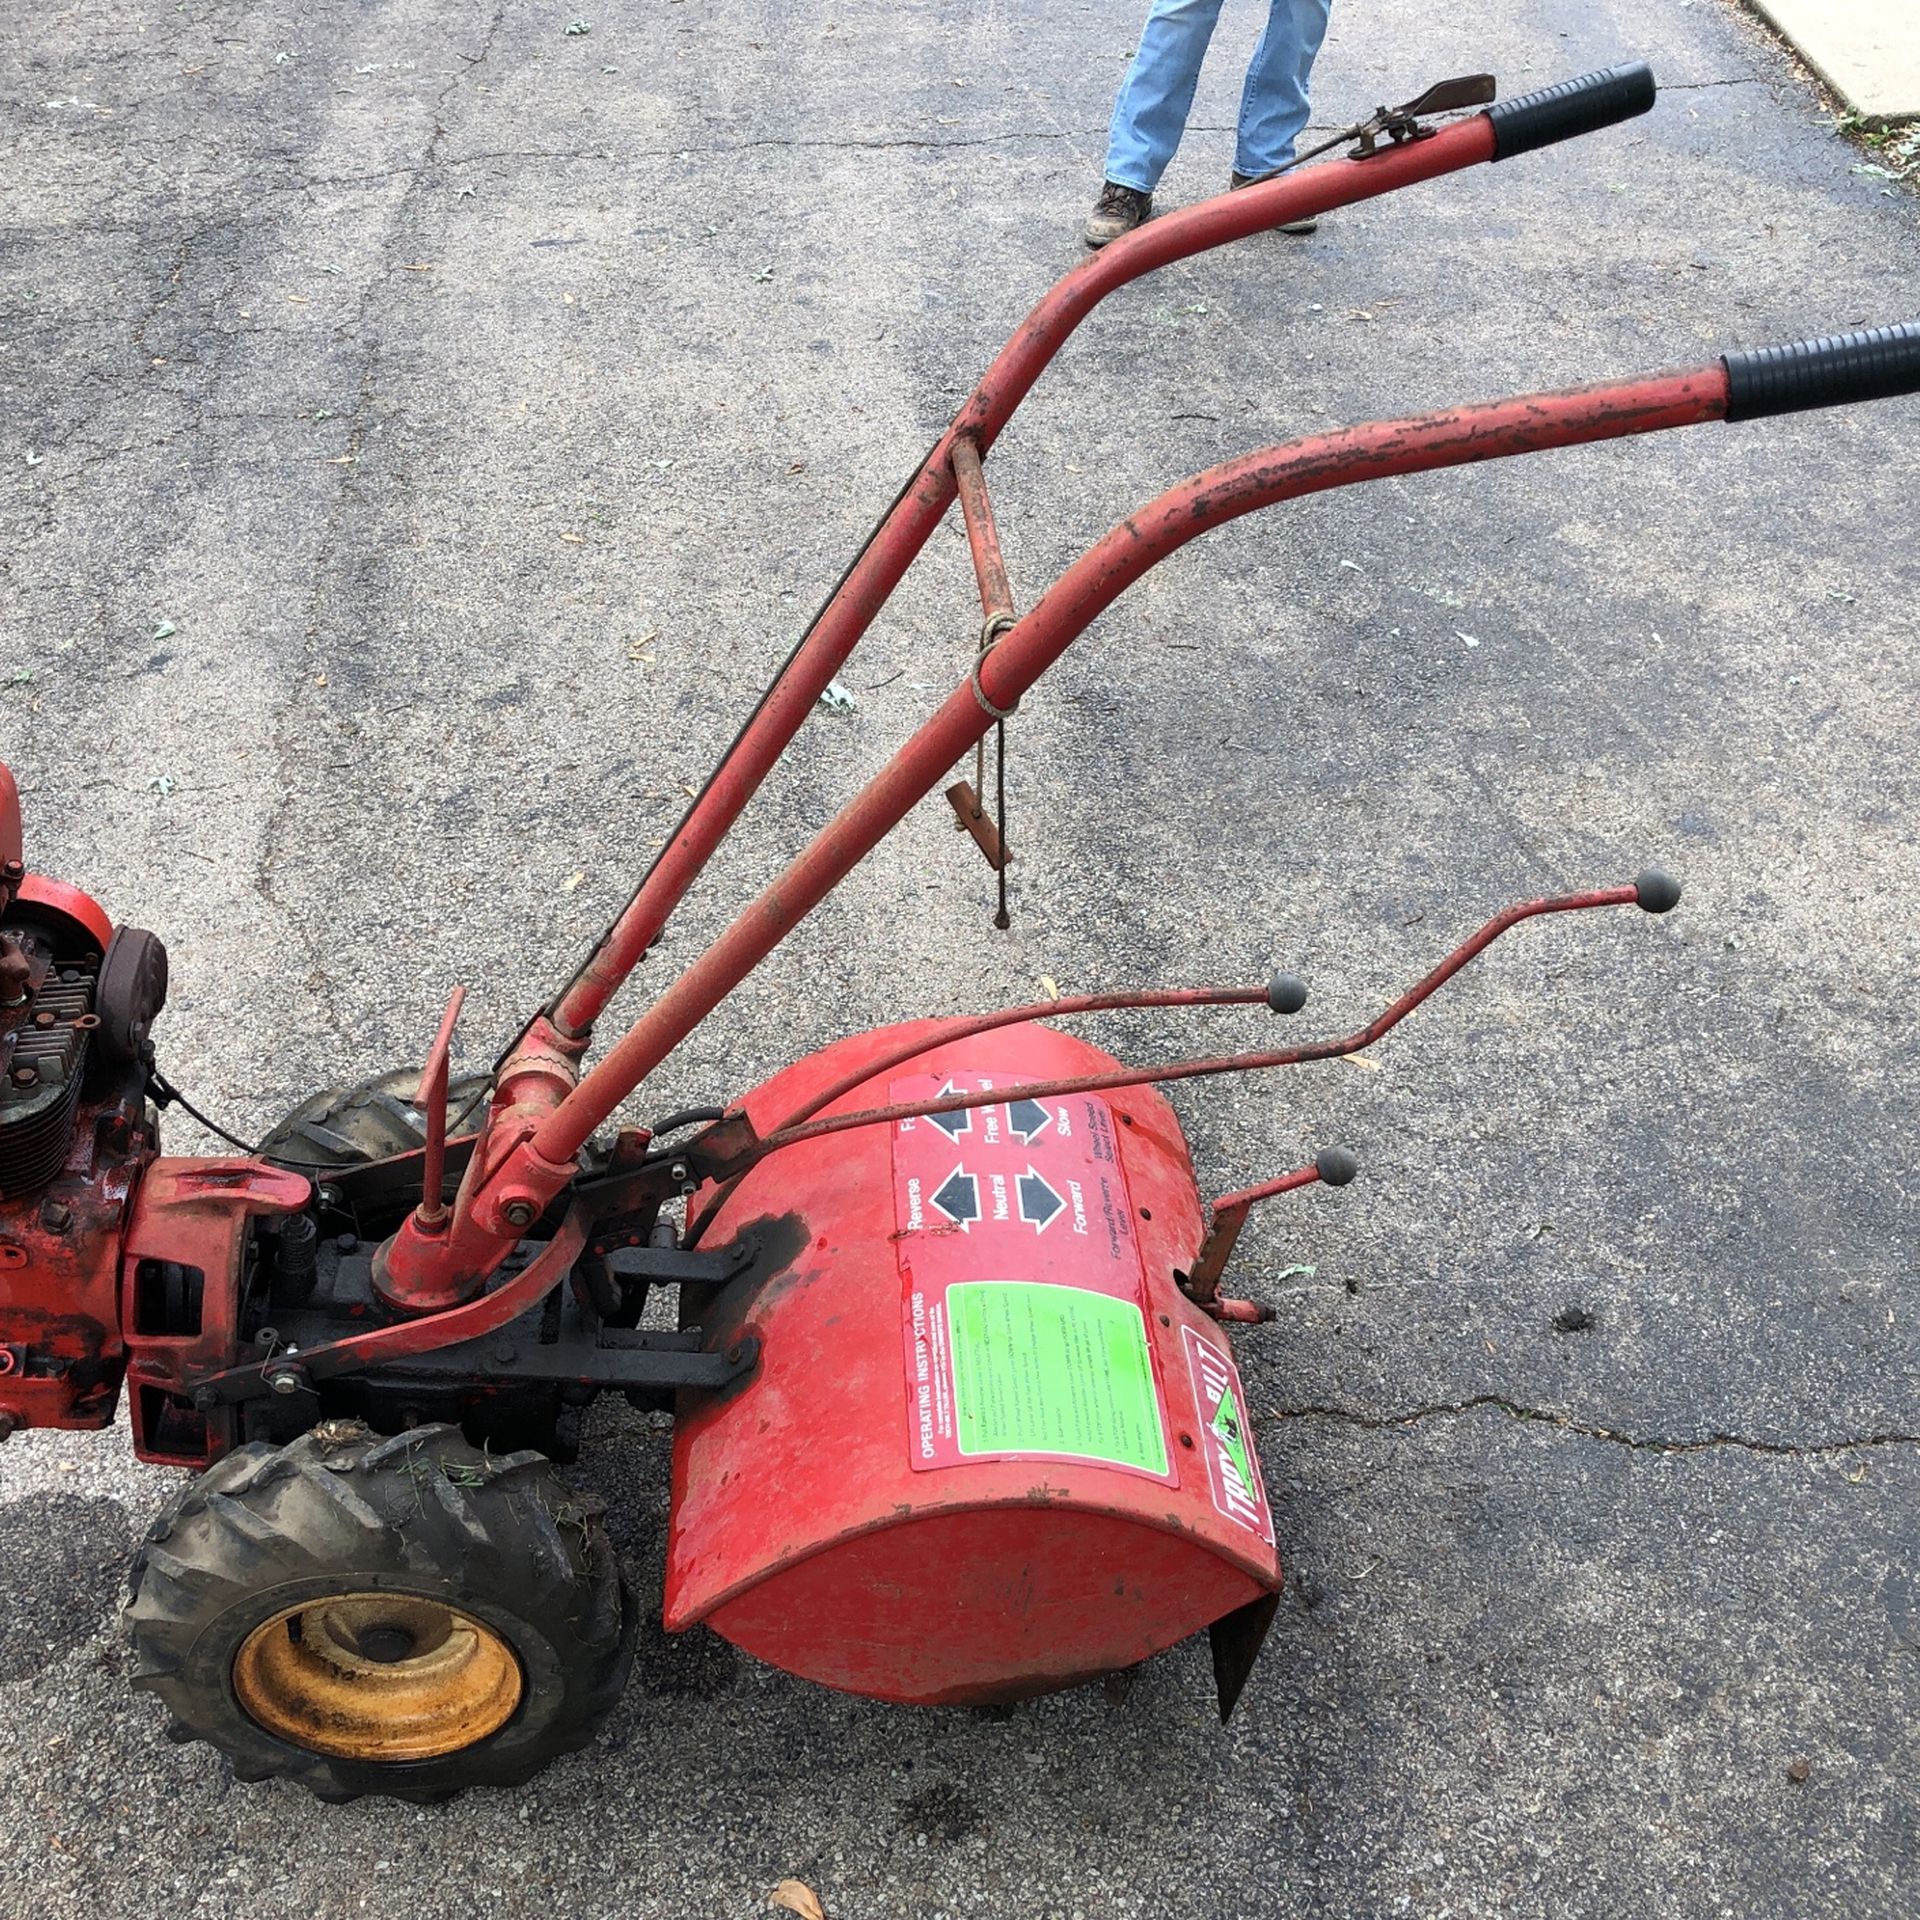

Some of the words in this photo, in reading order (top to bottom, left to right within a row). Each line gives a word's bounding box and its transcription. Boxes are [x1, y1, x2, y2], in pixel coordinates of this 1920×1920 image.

[977, 1079, 996, 1114] Wel
[901, 1115, 916, 1132] Fa
[984, 1117, 1000, 1144] Free
[1057, 1106, 1072, 1137] Slow
[1084, 1101, 1098, 1131] Speed
[1090, 1131, 1103, 1159] Wheel
[907, 1178, 923, 1230] Reverse
[989, 1174, 1009, 1220] Neutral
[1067, 1180, 1089, 1236] Forward
[1116, 1208, 1129, 1236] Lever
[1196, 1341, 1229, 1405] BILT
[917, 1384, 935, 1459] OPERATING
[1217, 1442, 1260, 1524] TROY
